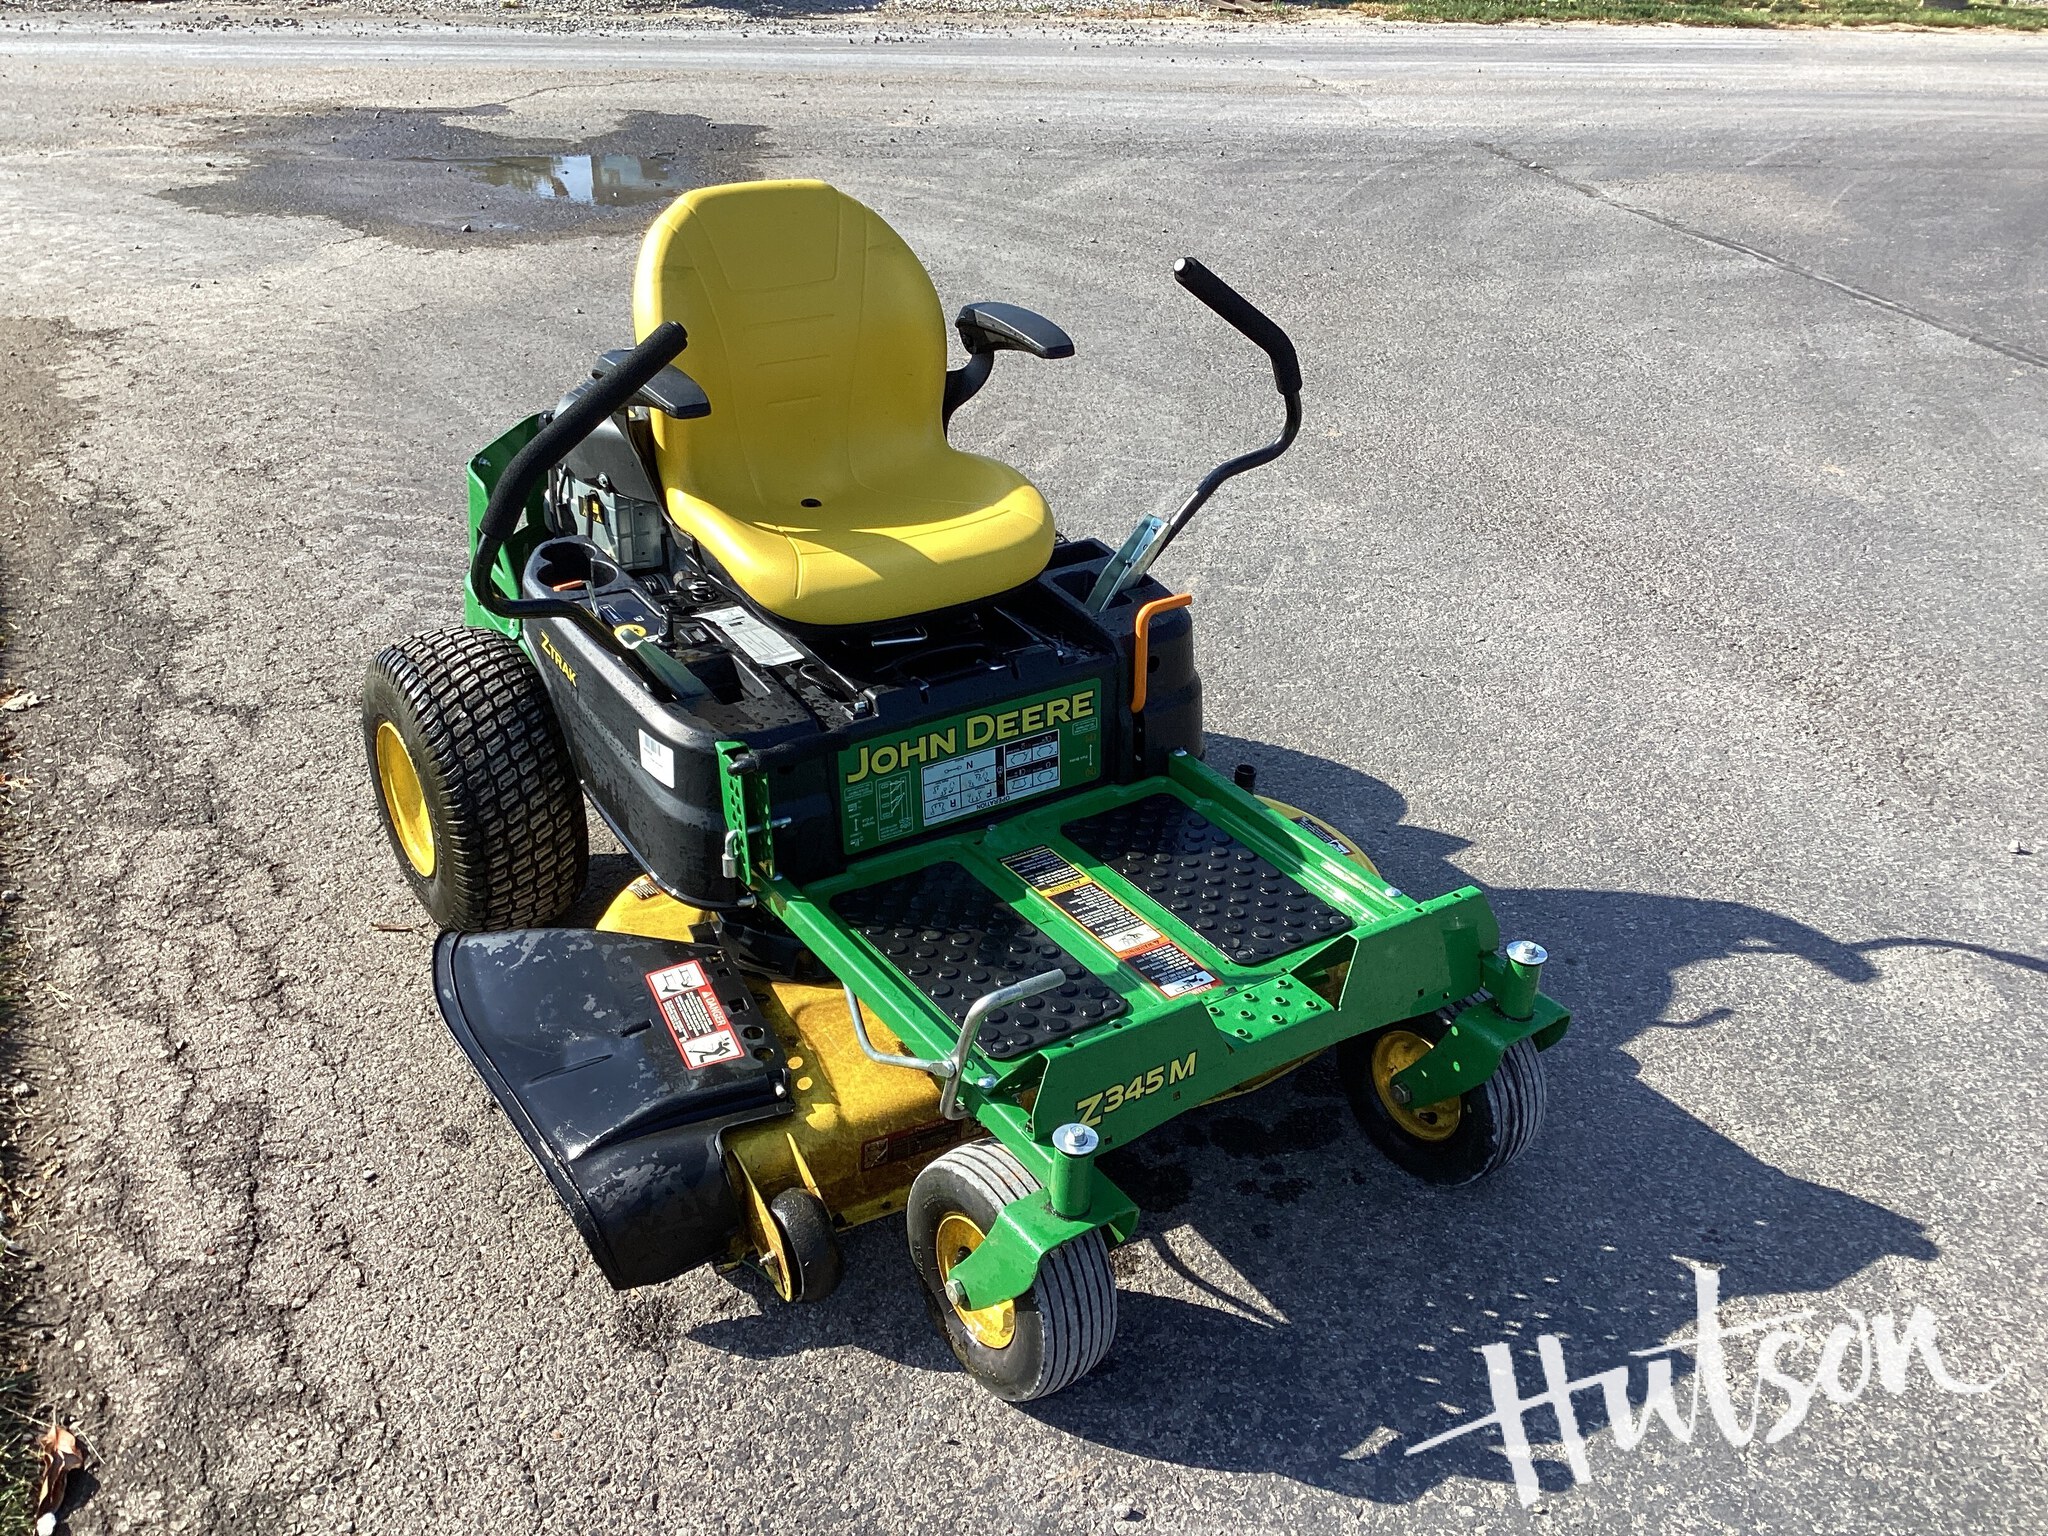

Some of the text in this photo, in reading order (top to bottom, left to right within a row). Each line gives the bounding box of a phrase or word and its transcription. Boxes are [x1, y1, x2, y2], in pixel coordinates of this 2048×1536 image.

[846, 689, 1095, 784] JOHN DEERE
[976, 796, 1011, 811] OPERATION
[705, 997, 727, 1027] DANGER
